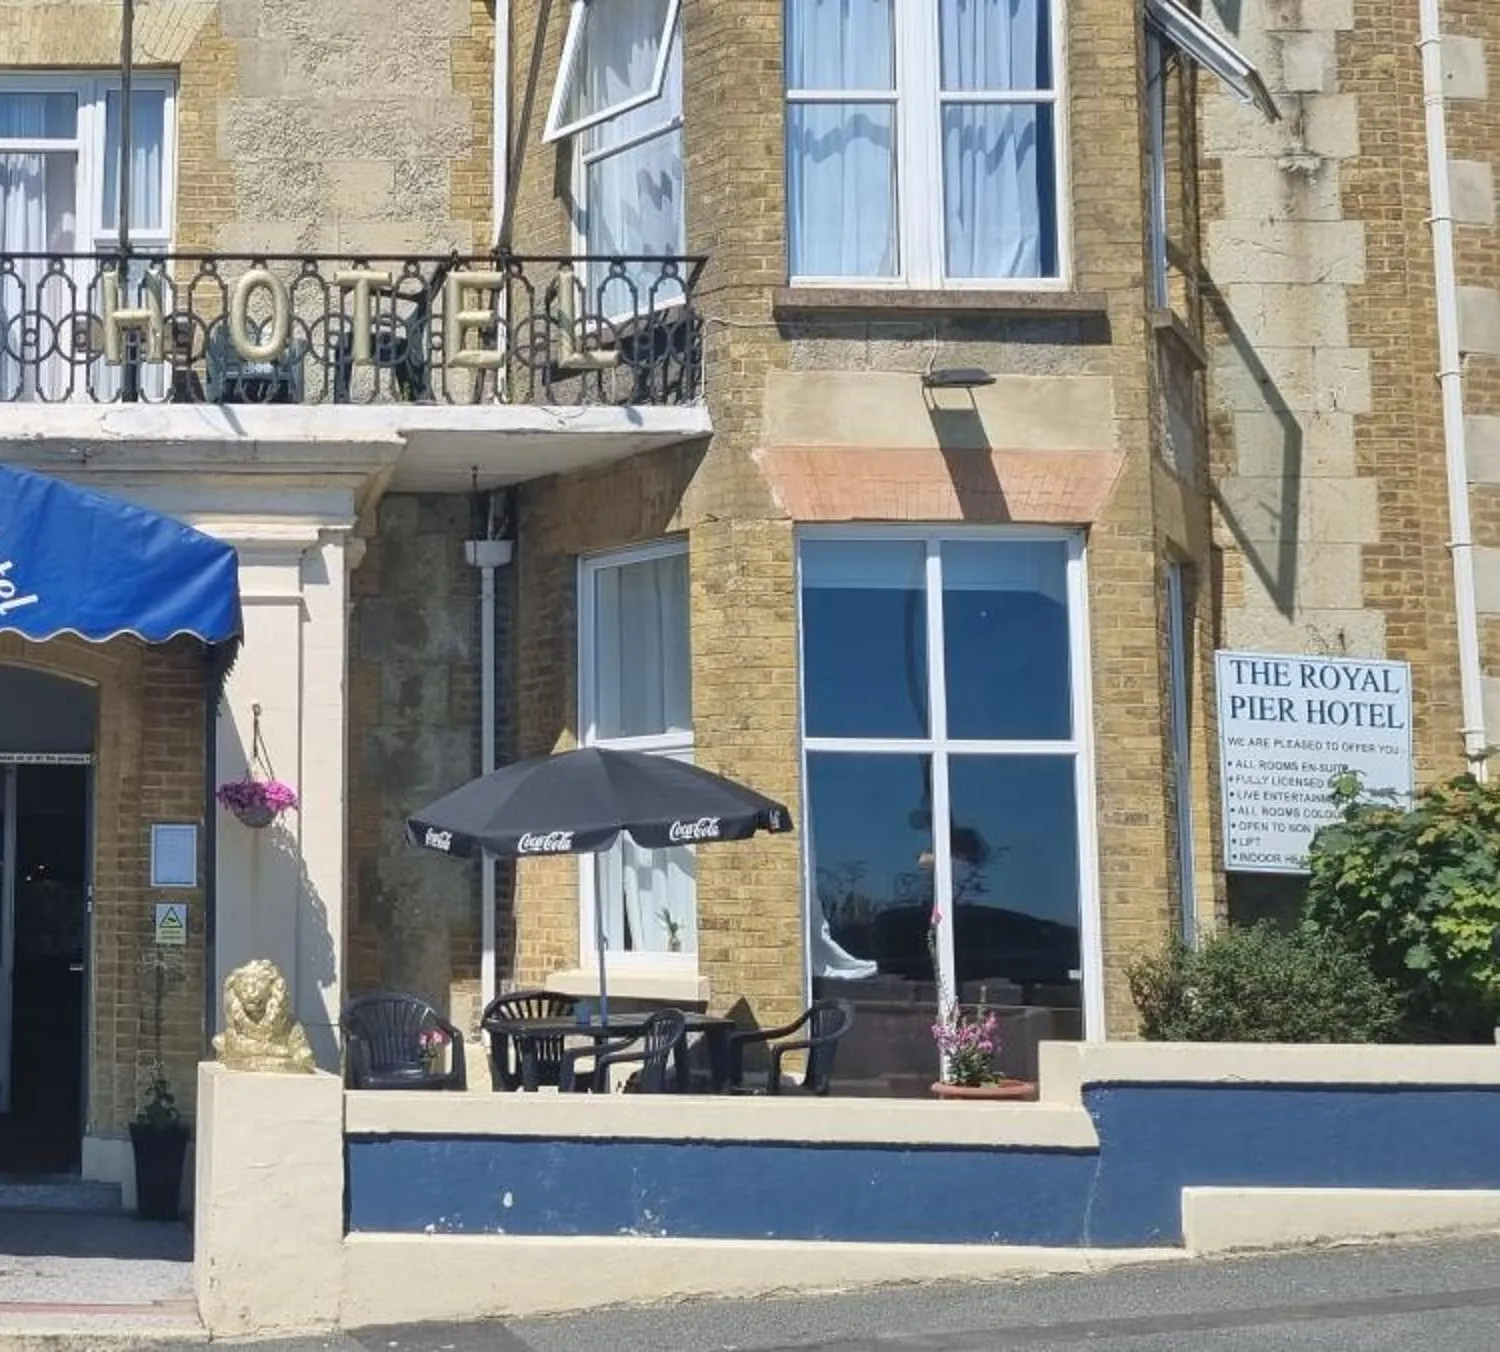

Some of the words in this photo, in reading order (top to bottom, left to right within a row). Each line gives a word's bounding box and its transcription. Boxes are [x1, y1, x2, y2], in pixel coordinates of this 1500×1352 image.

[103, 265, 620, 369] HOTEL
[1229, 659, 1291, 688] THE
[1300, 663, 1400, 694] ROYAL
[1230, 695, 1298, 723] PIER
[1306, 699, 1405, 729] HOTEL
[1227, 736, 1245, 747] WE
[1248, 737, 1270, 748] ARE
[1273, 738, 1323, 751] PLEASED
[1325, 740, 1339, 751] TO
[1235, 759, 1255, 769] ALL
[1259, 760, 1299, 771] ROOMS
[1271, 775, 1325, 789] LICENSED
[1238, 805, 1258, 817] ALL
[1261, 806, 1301, 818] ROOMS
[1238, 821, 1269, 832] OPEN
